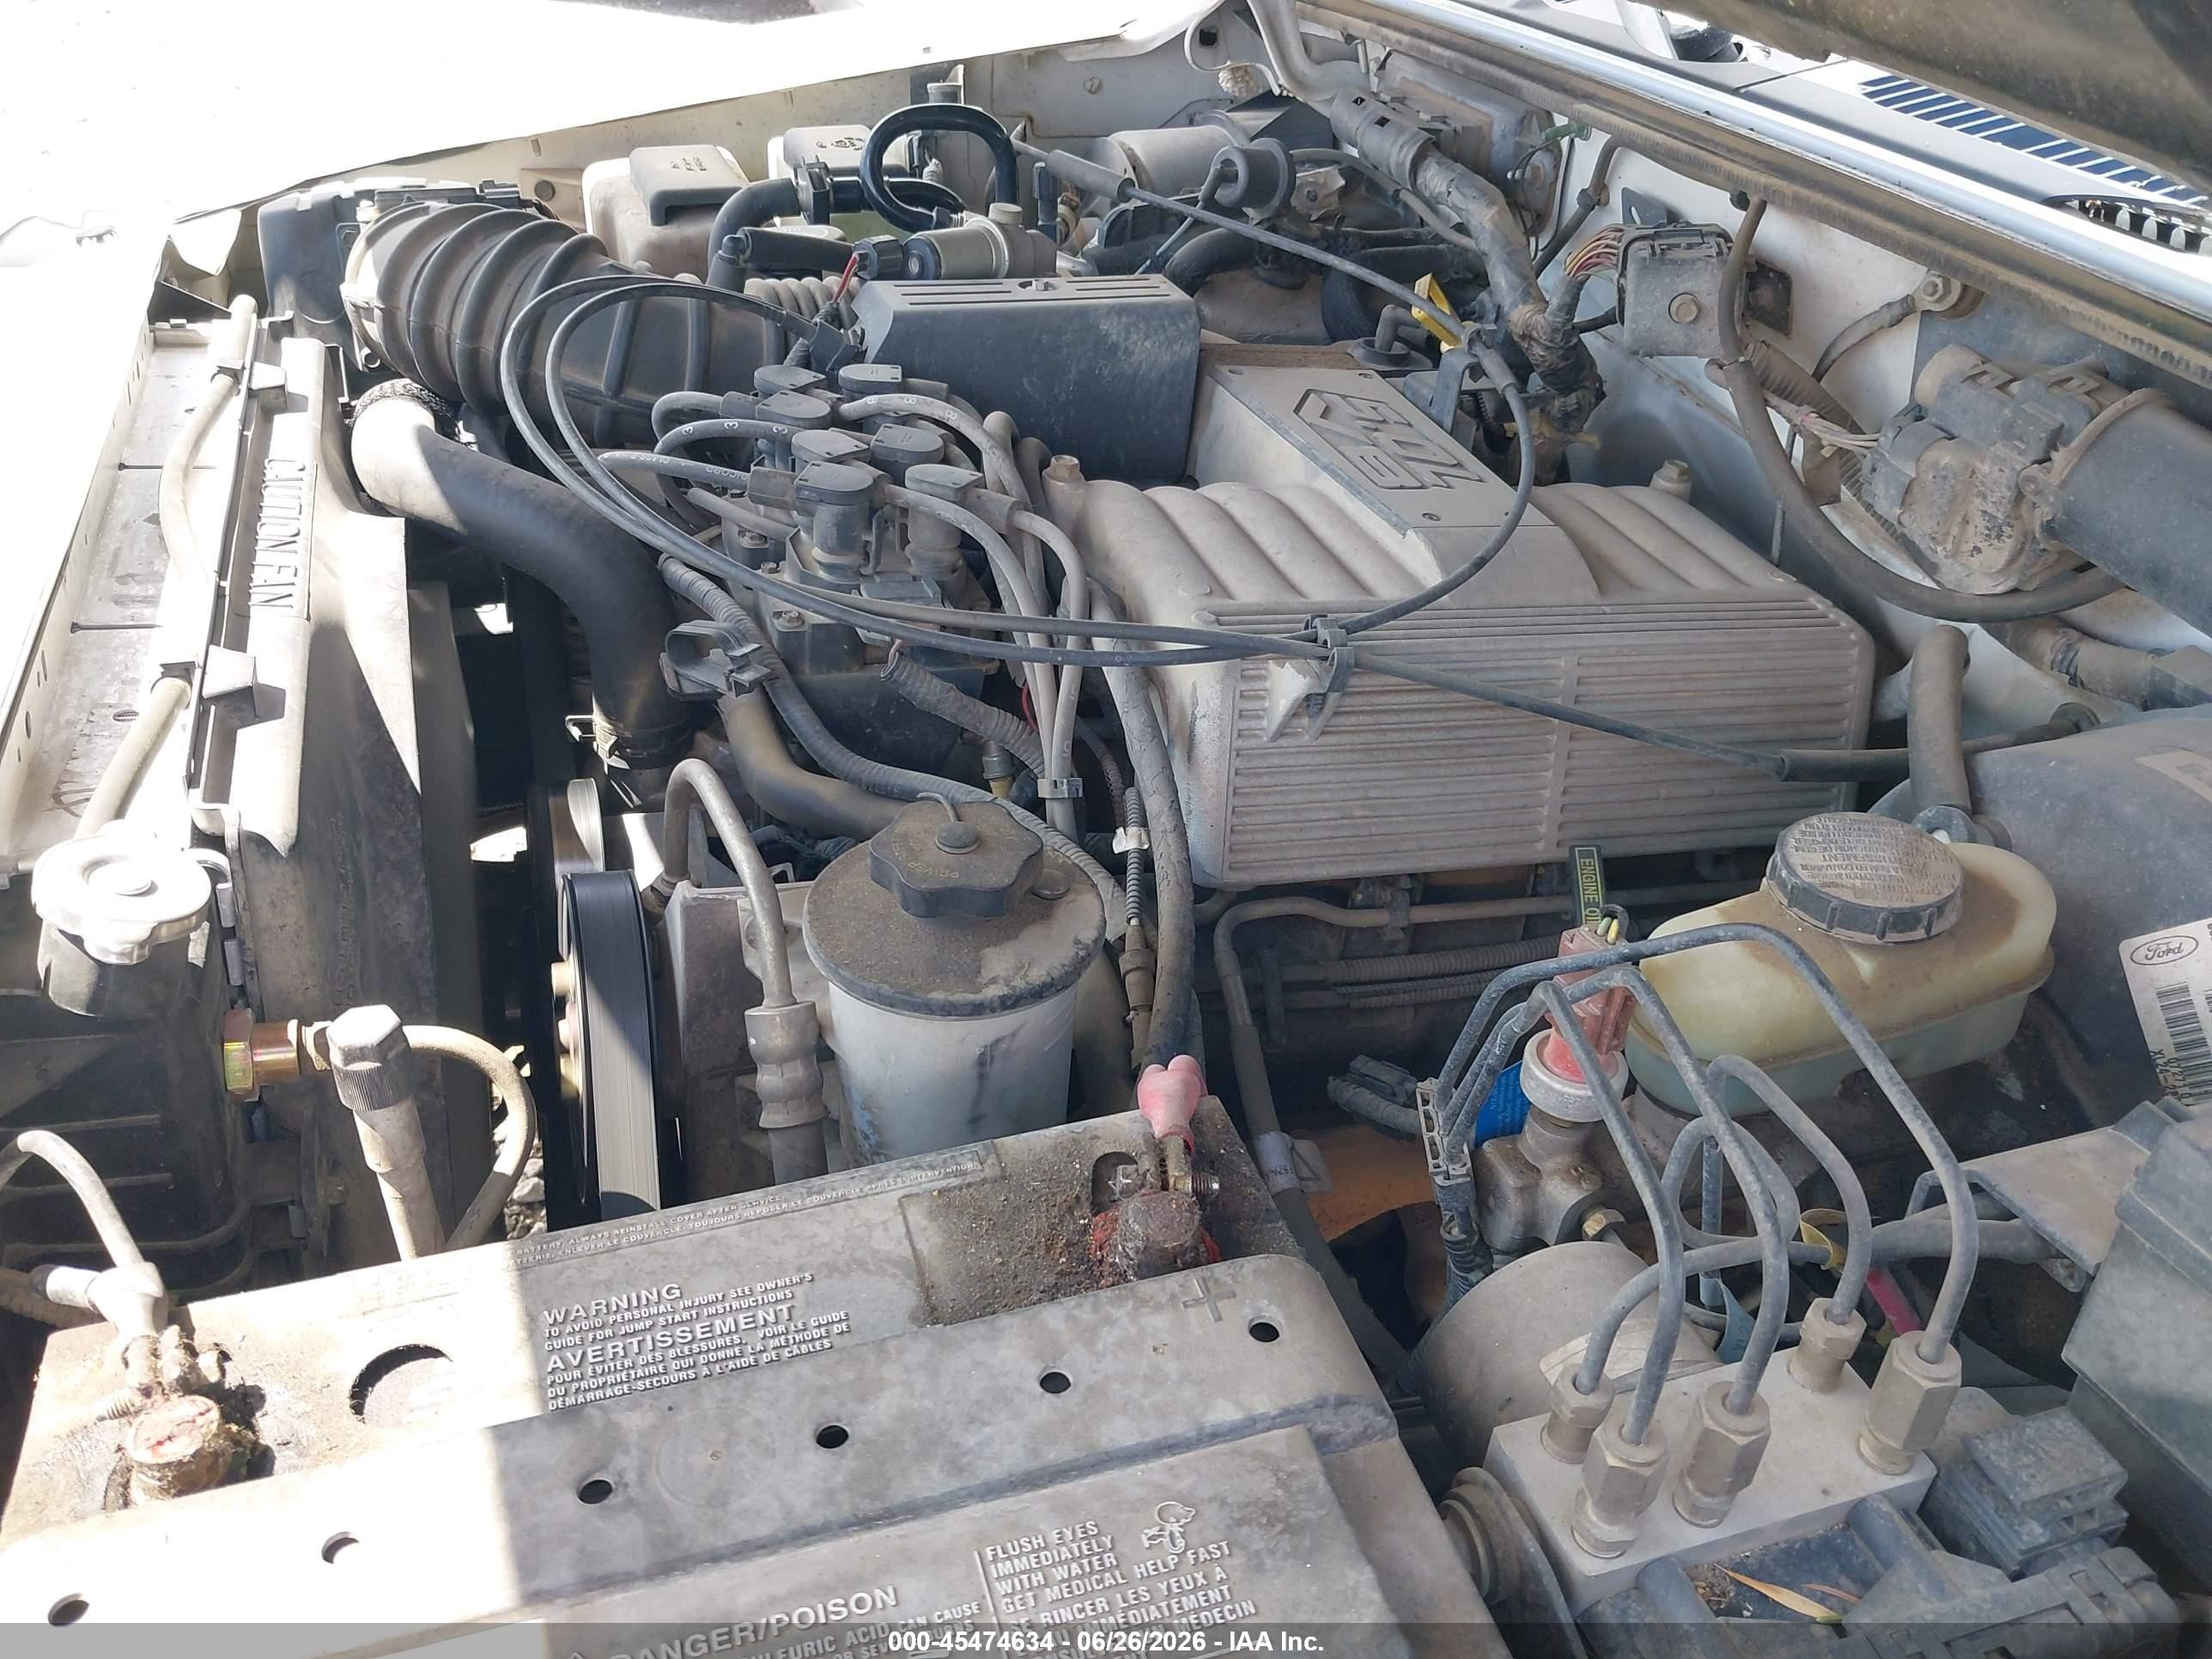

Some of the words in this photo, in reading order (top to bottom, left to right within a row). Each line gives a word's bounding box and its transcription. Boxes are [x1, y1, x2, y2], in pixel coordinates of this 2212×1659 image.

[1297, 392, 1424, 489] V8
[247, 561, 298, 609] FAN
[1580, 858, 1599, 902] ENGINE
[1585, 907, 1601, 922] OI
[2145, 941, 2185, 961] Ford
[568, 1231, 610, 1244] ALWAYS
[670, 1211, 703, 1224] COVER
[688, 1212, 741, 1229] TOUJOURS
[543, 1283, 682, 1325] WARNING
[543, 1327, 559, 1340] TO
[563, 1317, 604, 1335] AVOID
[607, 1301, 675, 1325] PERSONAL
[678, 1291, 725, 1310] INJURY
[729, 1285, 752, 1298] SEE
[757, 1271, 814, 1292] OWNER'S
[544, 1334, 584, 1352] GUIDE
[587, 1328, 614, 1342] FOR
[617, 1318, 654, 1336] JUMP
[658, 1309, 698, 1327] START
[702, 1288, 793, 1317] INSTRUCTIONS
[544, 1302, 797, 1373] AVERTISSEMENT
[546, 1369, 582, 1387] POUR
[638, 1351, 664, 1365] DES
[757, 1323, 788, 1340] VOIR
[791, 1319, 807, 1332] LE
[810, 1309, 850, 1328] GUIDE
[547, 1384, 567, 1399] DU
[570, 1360, 668, 1393] PROPRIÉTAIRE
[671, 1357, 696, 1371] QUI
[699, 1346, 744, 1364] DONNE
[747, 1340, 765, 1354] LA
[768, 1325, 830, 1349] MÉTHODE
[833, 1322, 850, 1334] DE
[714, 1354, 757, 1374] L'AIDE
[763, 1350, 781, 1363] DE
[985, 1532, 1045, 1562] FLUSH
[1053, 1518, 1100, 1544] EYES
[989, 1533, 1115, 1579] IMMEDIATELY
[994, 1570, 1045, 1596] WITH
[1053, 1551, 1119, 1581] WATER
[1001, 1590, 1038, 1614] GET
[1044, 1567, 1128, 1602] MEDICAL
[1133, 1553, 1182, 1580] HELP
[1187, 1539, 1232, 1565] FAST
[1040, 1595, 1110, 1628] RINCER
[1111, 1587, 1144, 1609] LES
[1158, 1570, 1208, 1597] YEUX
[1212, 1560, 1228, 1582] À
[610, 1585, 899, 1659] NGER/POISON
[846, 1621, 890, 1648] ACID
[933, 1601, 981, 1623] CAUSE
[1170, 1595, 1257, 1635] MÉDECIN
